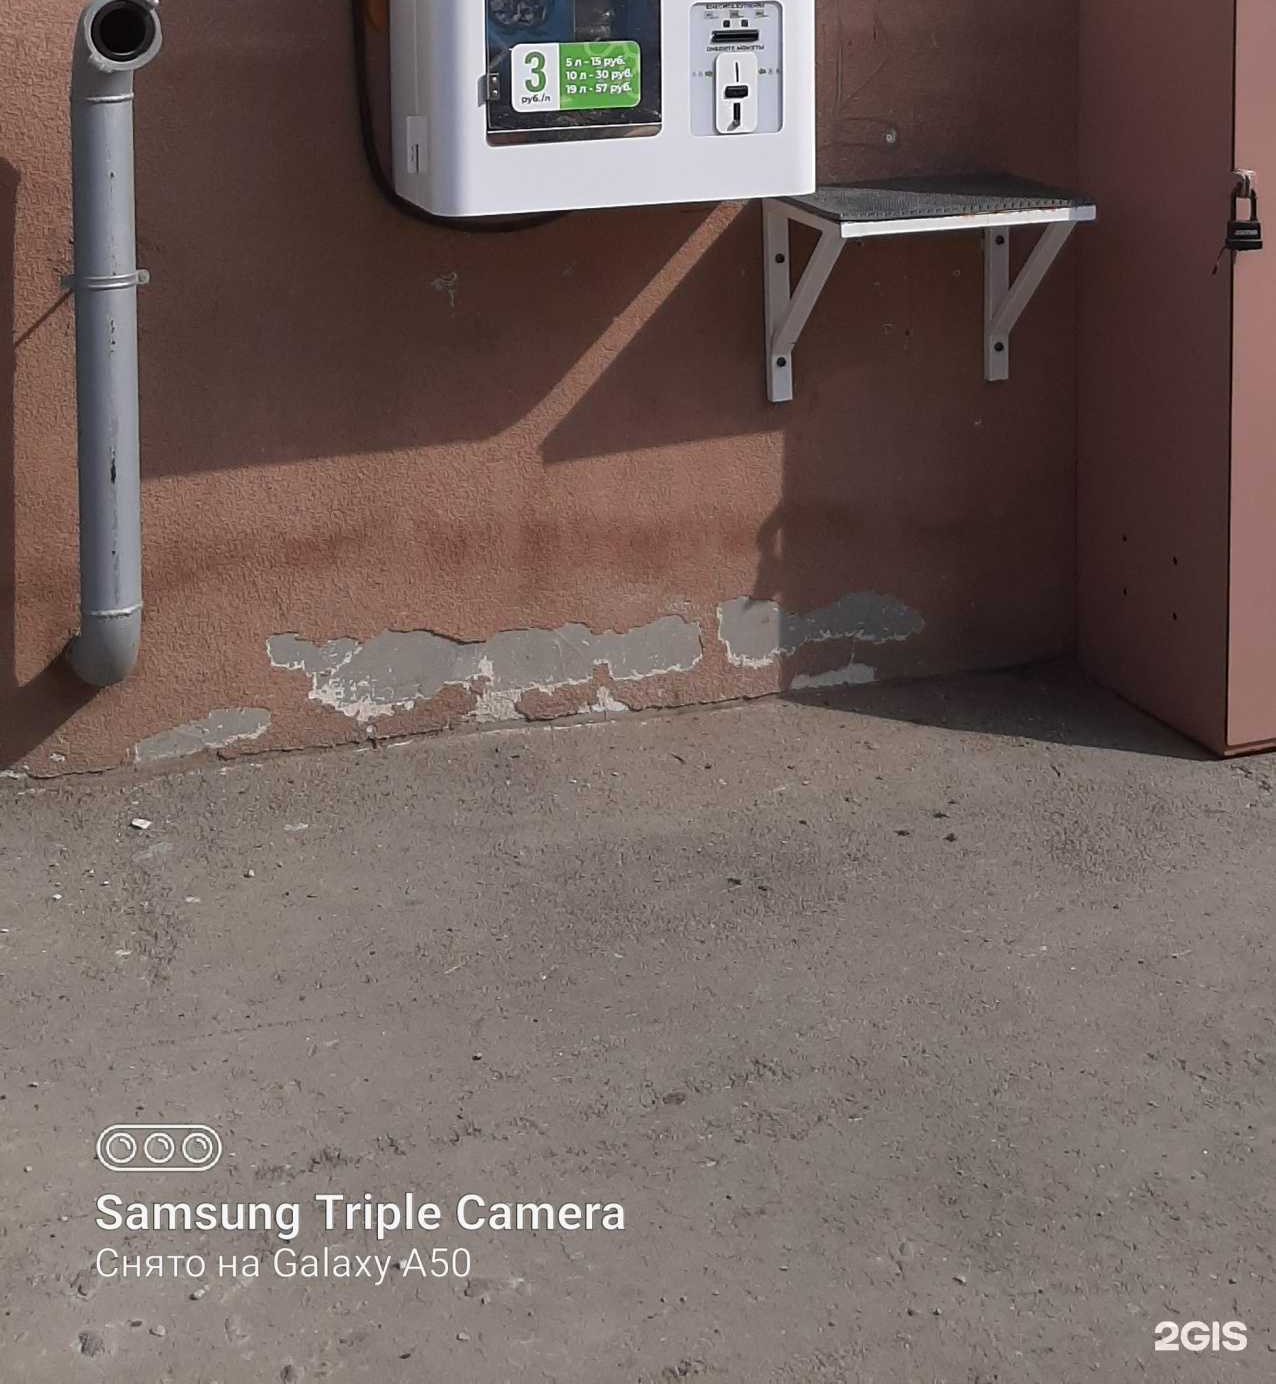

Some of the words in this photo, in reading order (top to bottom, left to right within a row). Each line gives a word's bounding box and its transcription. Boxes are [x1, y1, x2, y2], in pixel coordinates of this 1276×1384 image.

[565, 58, 573, 67] 5
[574, 59, 582, 67] л
[591, 57, 602, 66] 15
[604, 56, 626, 67] руб.
[524, 51, 547, 93] 3
[566, 71, 577, 80] 10
[580, 72, 587, 80] л
[595, 70, 609, 79] 30
[611, 68, 632, 80] руб.
[566, 84, 577, 94] 19
[580, 86, 587, 94] л
[595, 83, 608, 93] 57
[610, 82, 632, 94] руб.
[521, 94, 551, 105] руб./л
